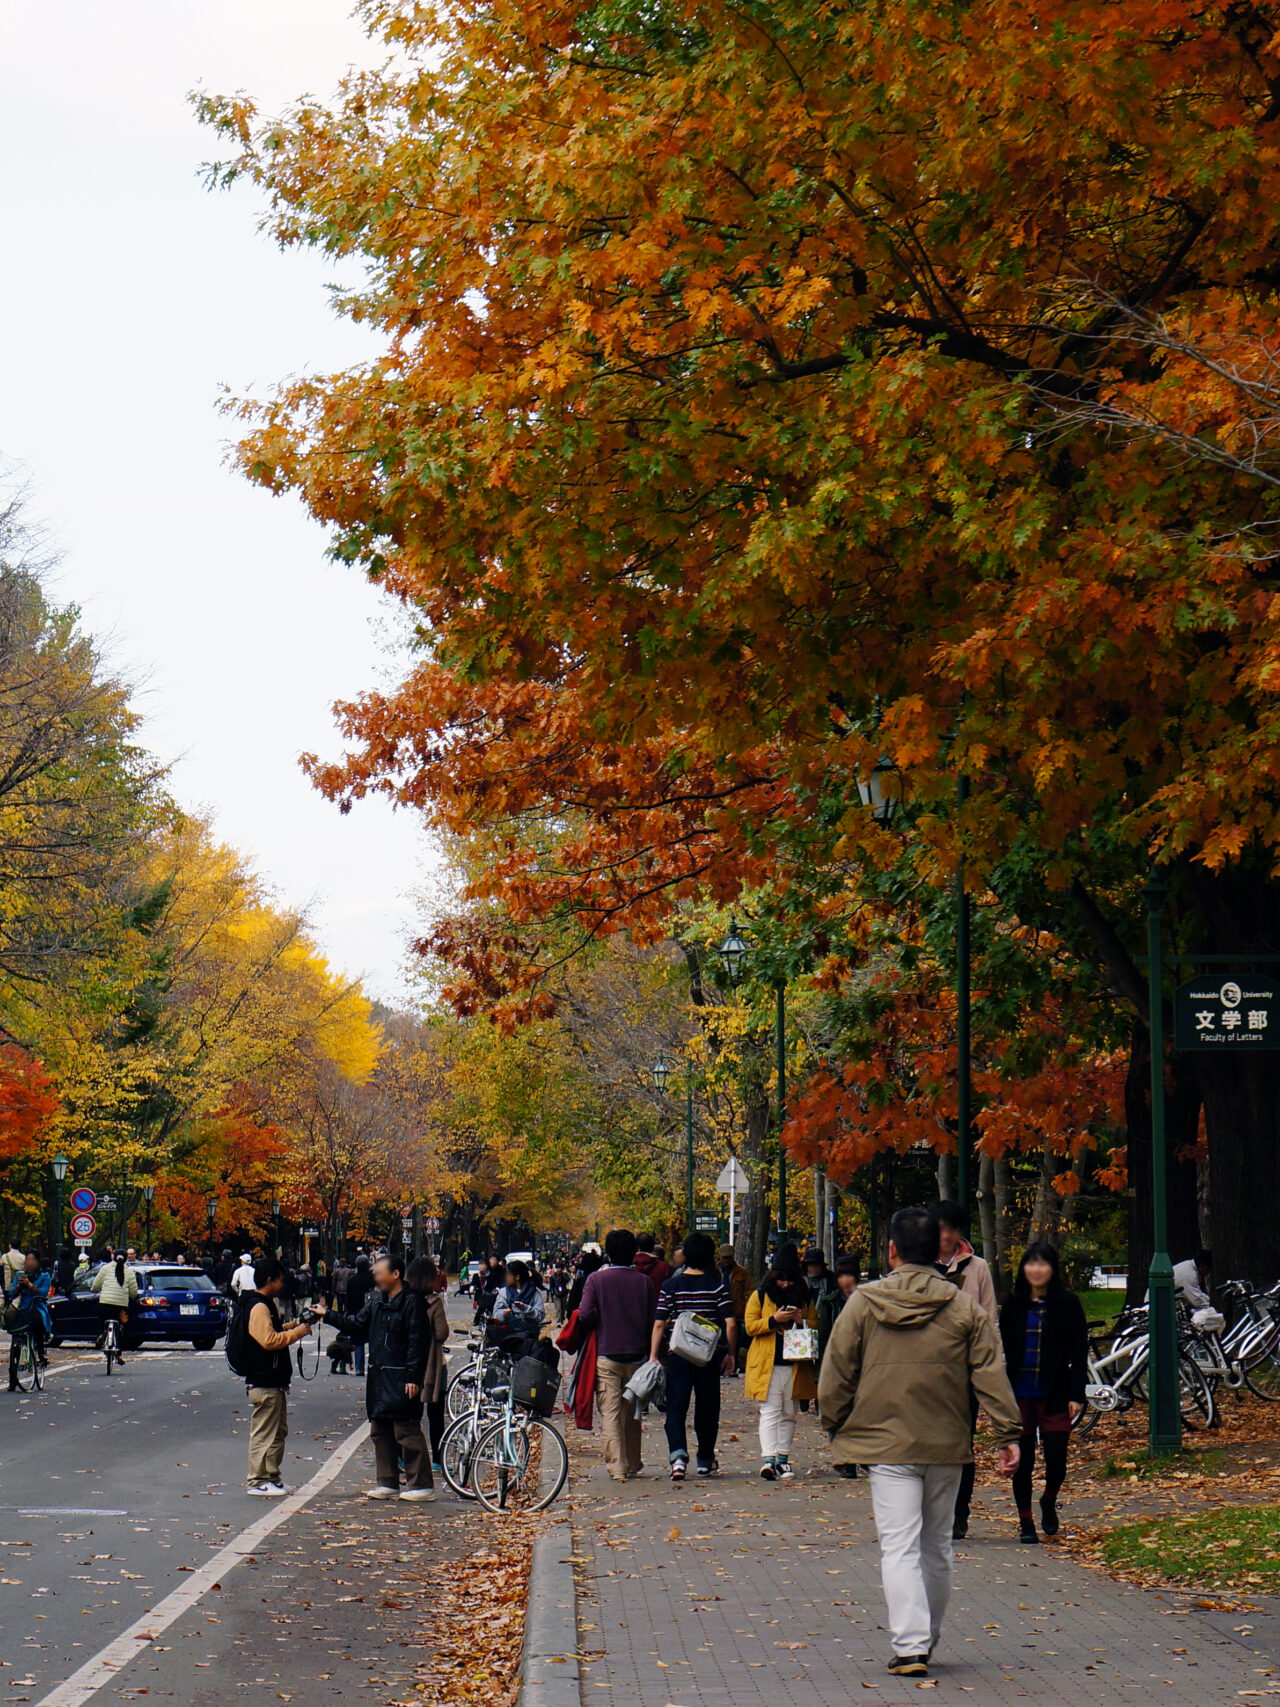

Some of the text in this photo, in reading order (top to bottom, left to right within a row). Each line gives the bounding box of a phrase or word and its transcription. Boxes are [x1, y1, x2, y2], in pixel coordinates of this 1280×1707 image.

[1195, 1010, 1268, 1030] 文学部
[1200, 1033, 1263, 1042] Faculty of Letters
[76, 1221, 90, 1232] 25
